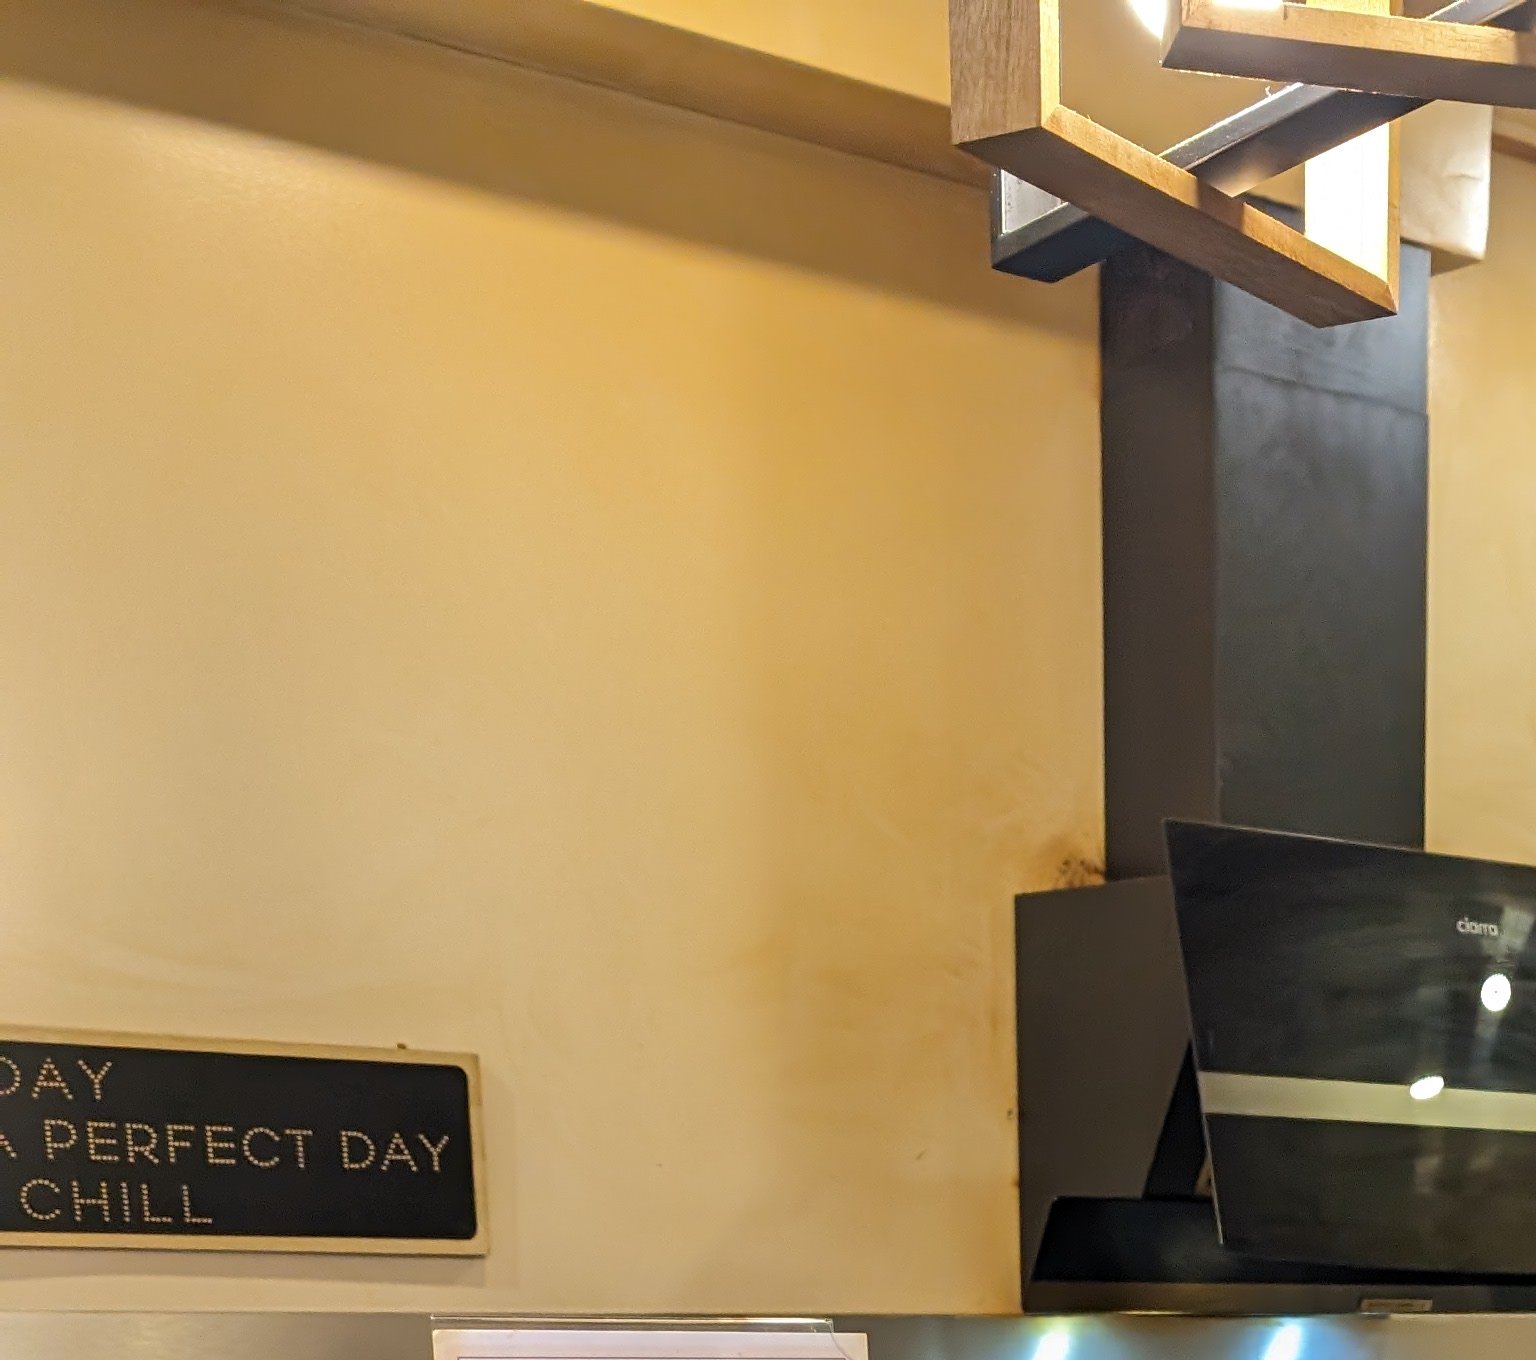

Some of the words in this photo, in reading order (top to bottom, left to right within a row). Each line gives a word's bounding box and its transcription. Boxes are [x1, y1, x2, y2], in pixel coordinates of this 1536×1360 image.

[43, 1117, 314, 1169] PERFECT
[340, 1130, 450, 1173] DAY
[20, 1178, 214, 1225] CHILL
